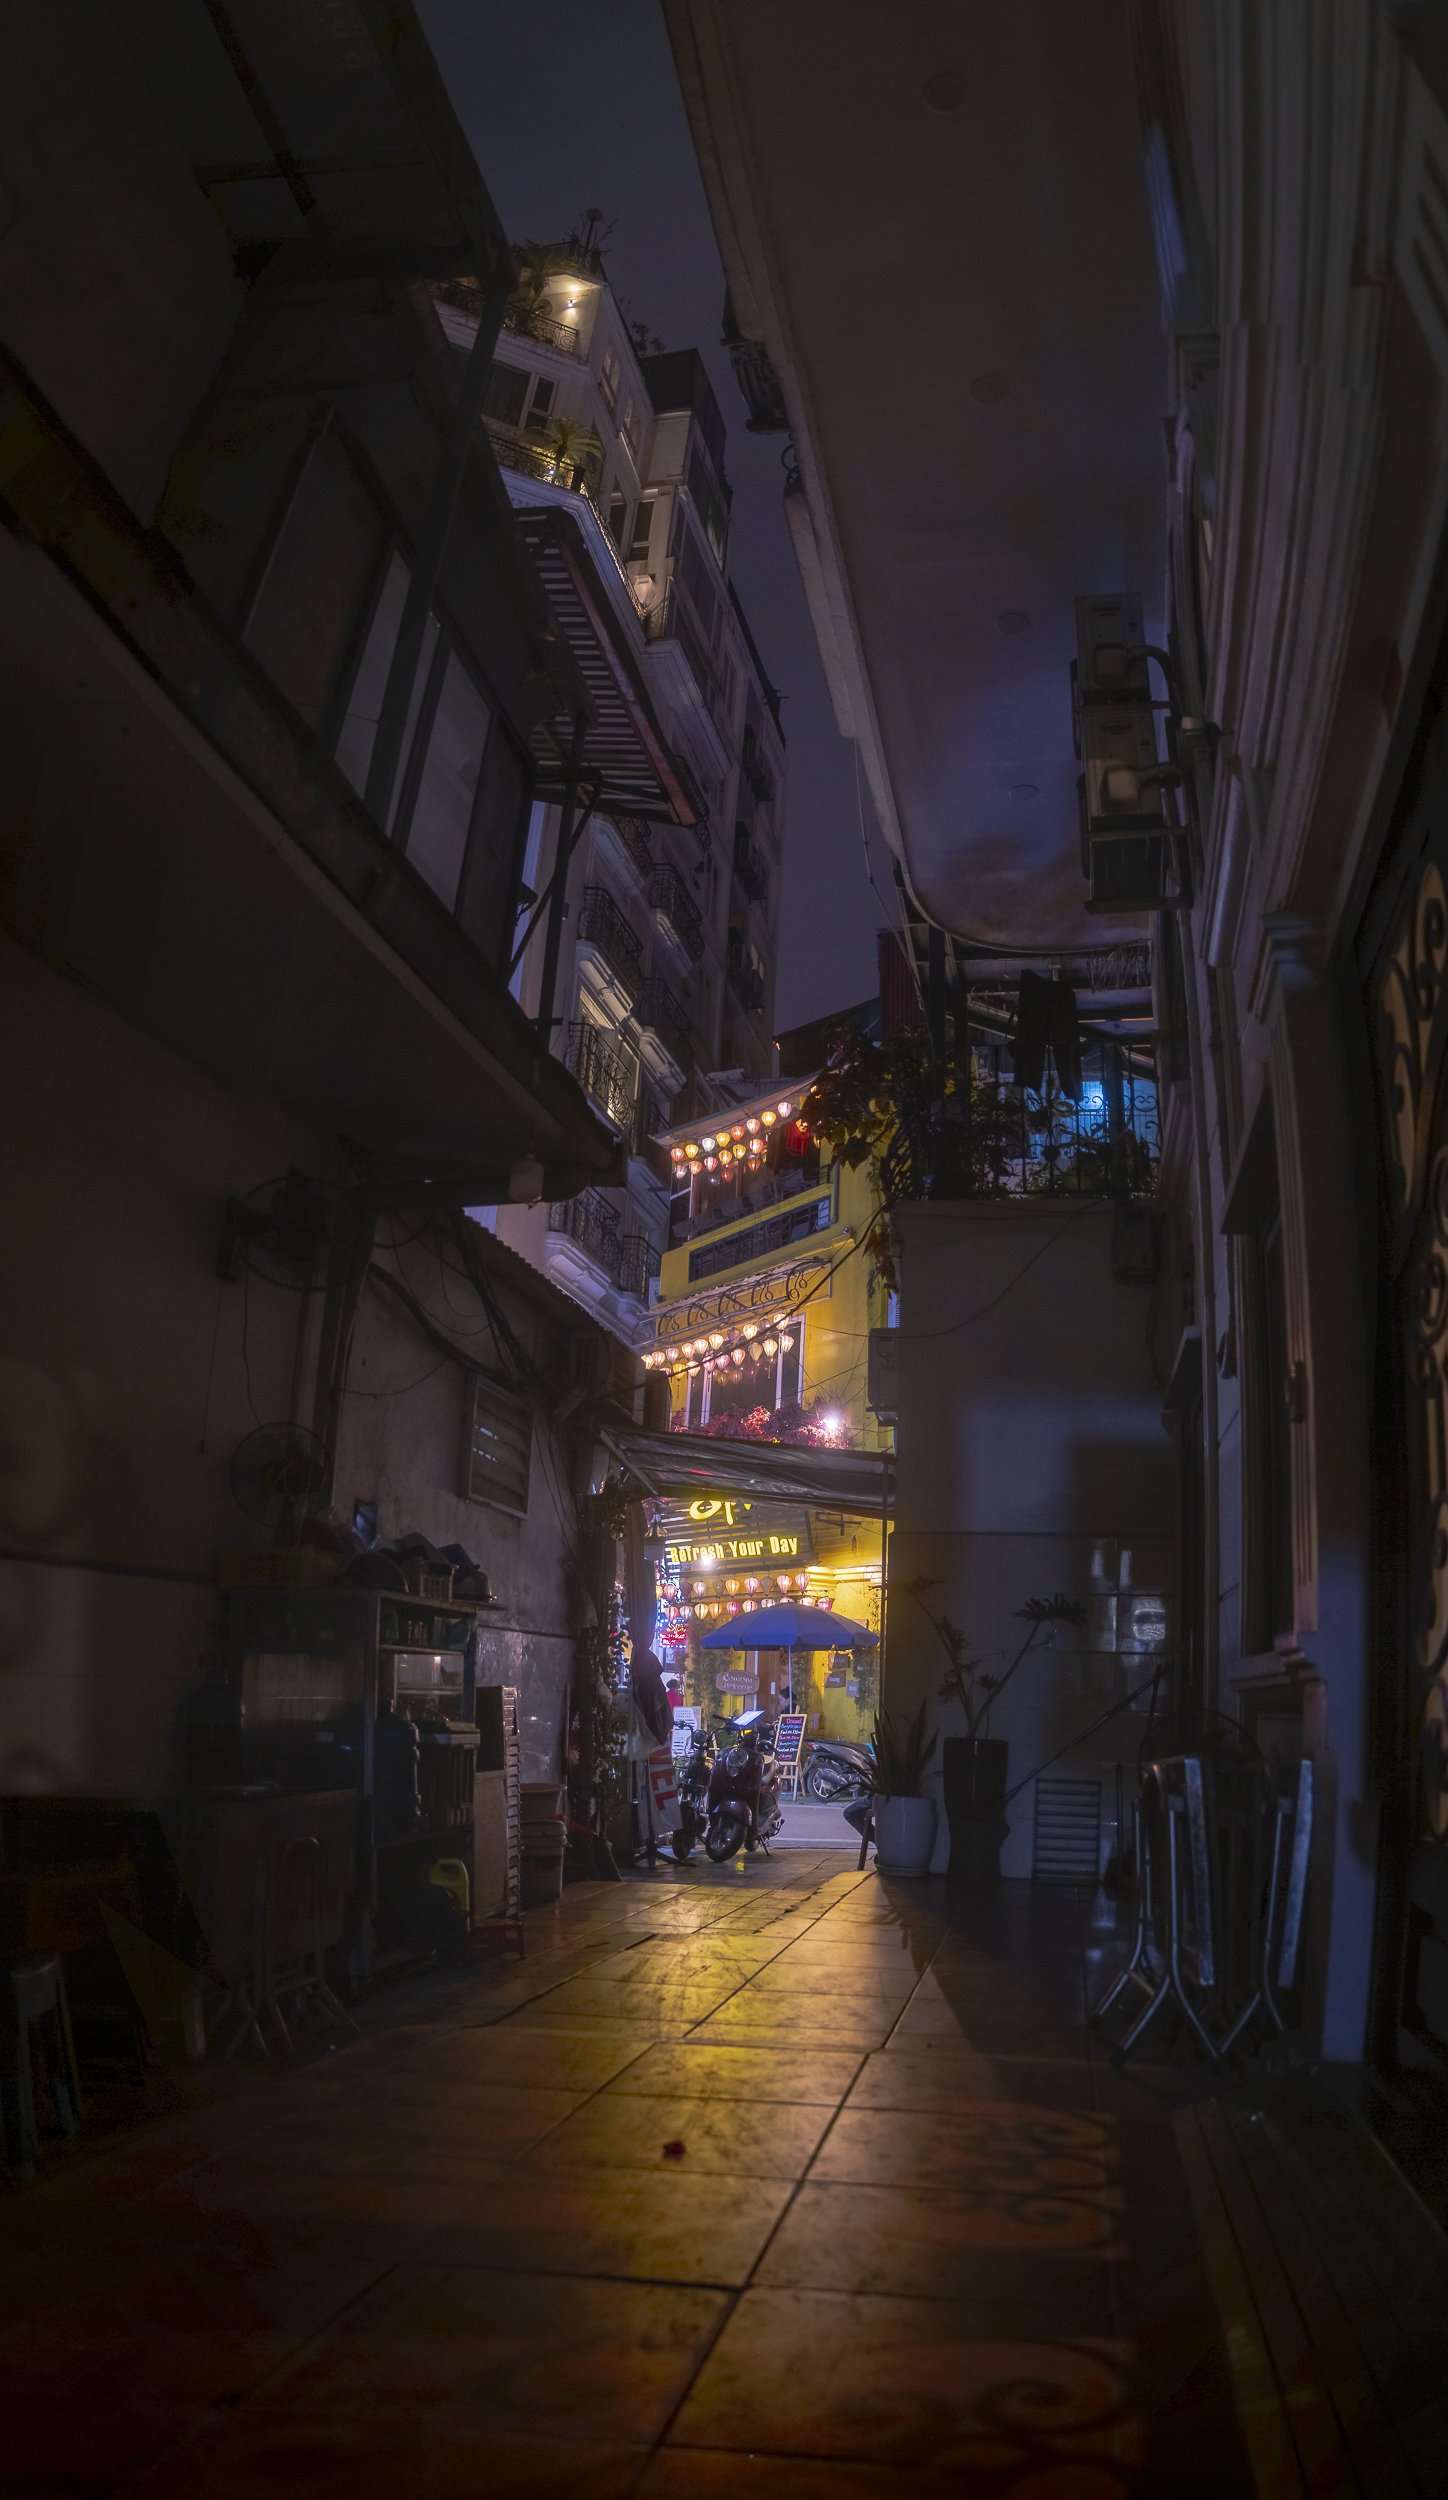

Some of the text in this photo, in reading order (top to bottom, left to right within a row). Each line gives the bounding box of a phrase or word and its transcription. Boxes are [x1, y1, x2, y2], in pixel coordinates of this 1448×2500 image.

[670, 1536, 797, 1563] Refresh Your Day
[648, 1745, 678, 1811] VEL
